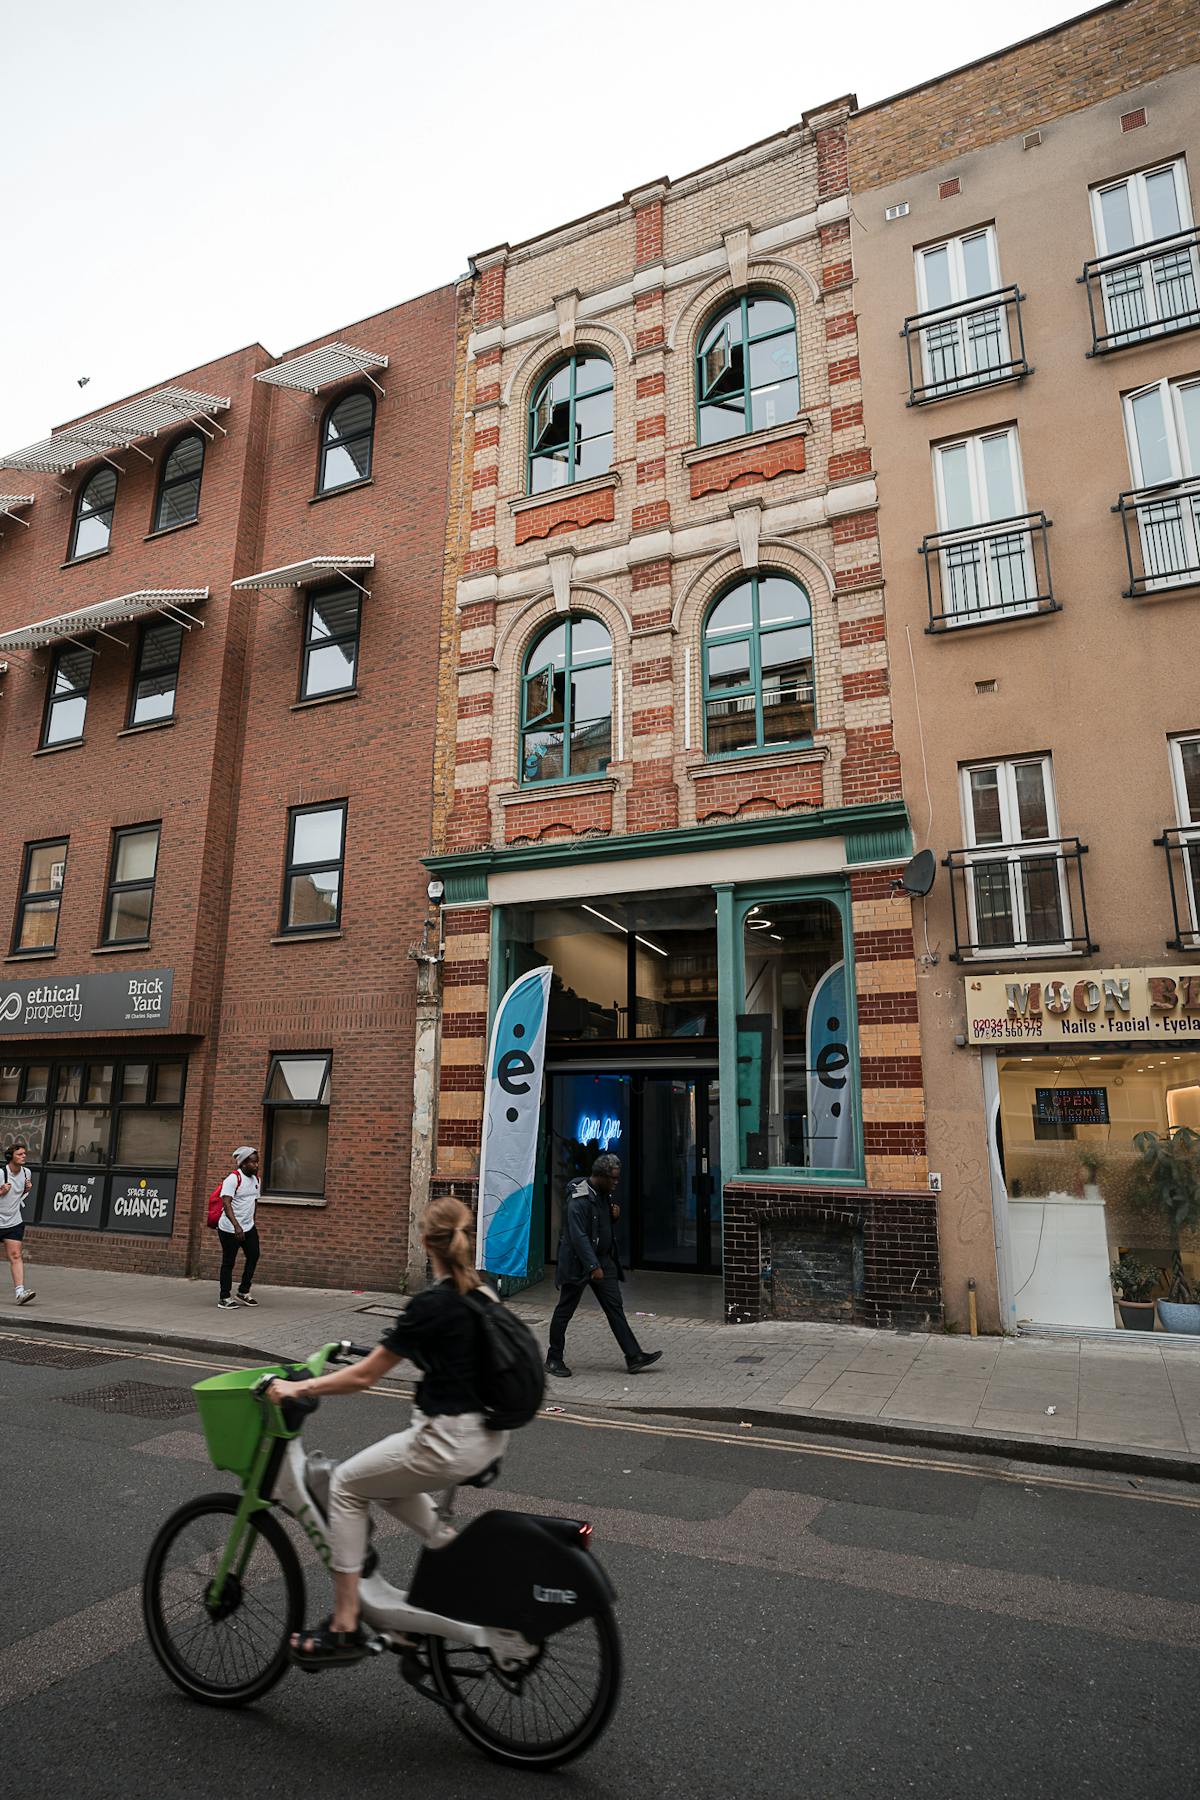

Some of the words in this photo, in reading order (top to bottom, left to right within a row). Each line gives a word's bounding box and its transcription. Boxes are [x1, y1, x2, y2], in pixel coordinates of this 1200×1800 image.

[27, 984, 81, 1004] ethical
[128, 978, 163, 995] Brick
[132, 995, 162, 1011] Yard
[1005, 979, 1131, 1017] MOON
[24, 1002, 83, 1024] property
[1061, 1018, 1096, 1034] Nails
[1107, 1016, 1150, 1032] Facial
[498, 1049, 535, 1095] e
[817, 1043, 849, 1089] e
[1051, 1095, 1092, 1106] OPEN
[1045, 1106, 1101, 1117] Welcome
[62, 1183, 79, 1192] SPACE
[127, 1188, 145, 1197] SPACE
[146, 1189, 158, 1197] FOR
[53, 1192, 93, 1213] GROW
[114, 1197, 168, 1218] CHANGE
